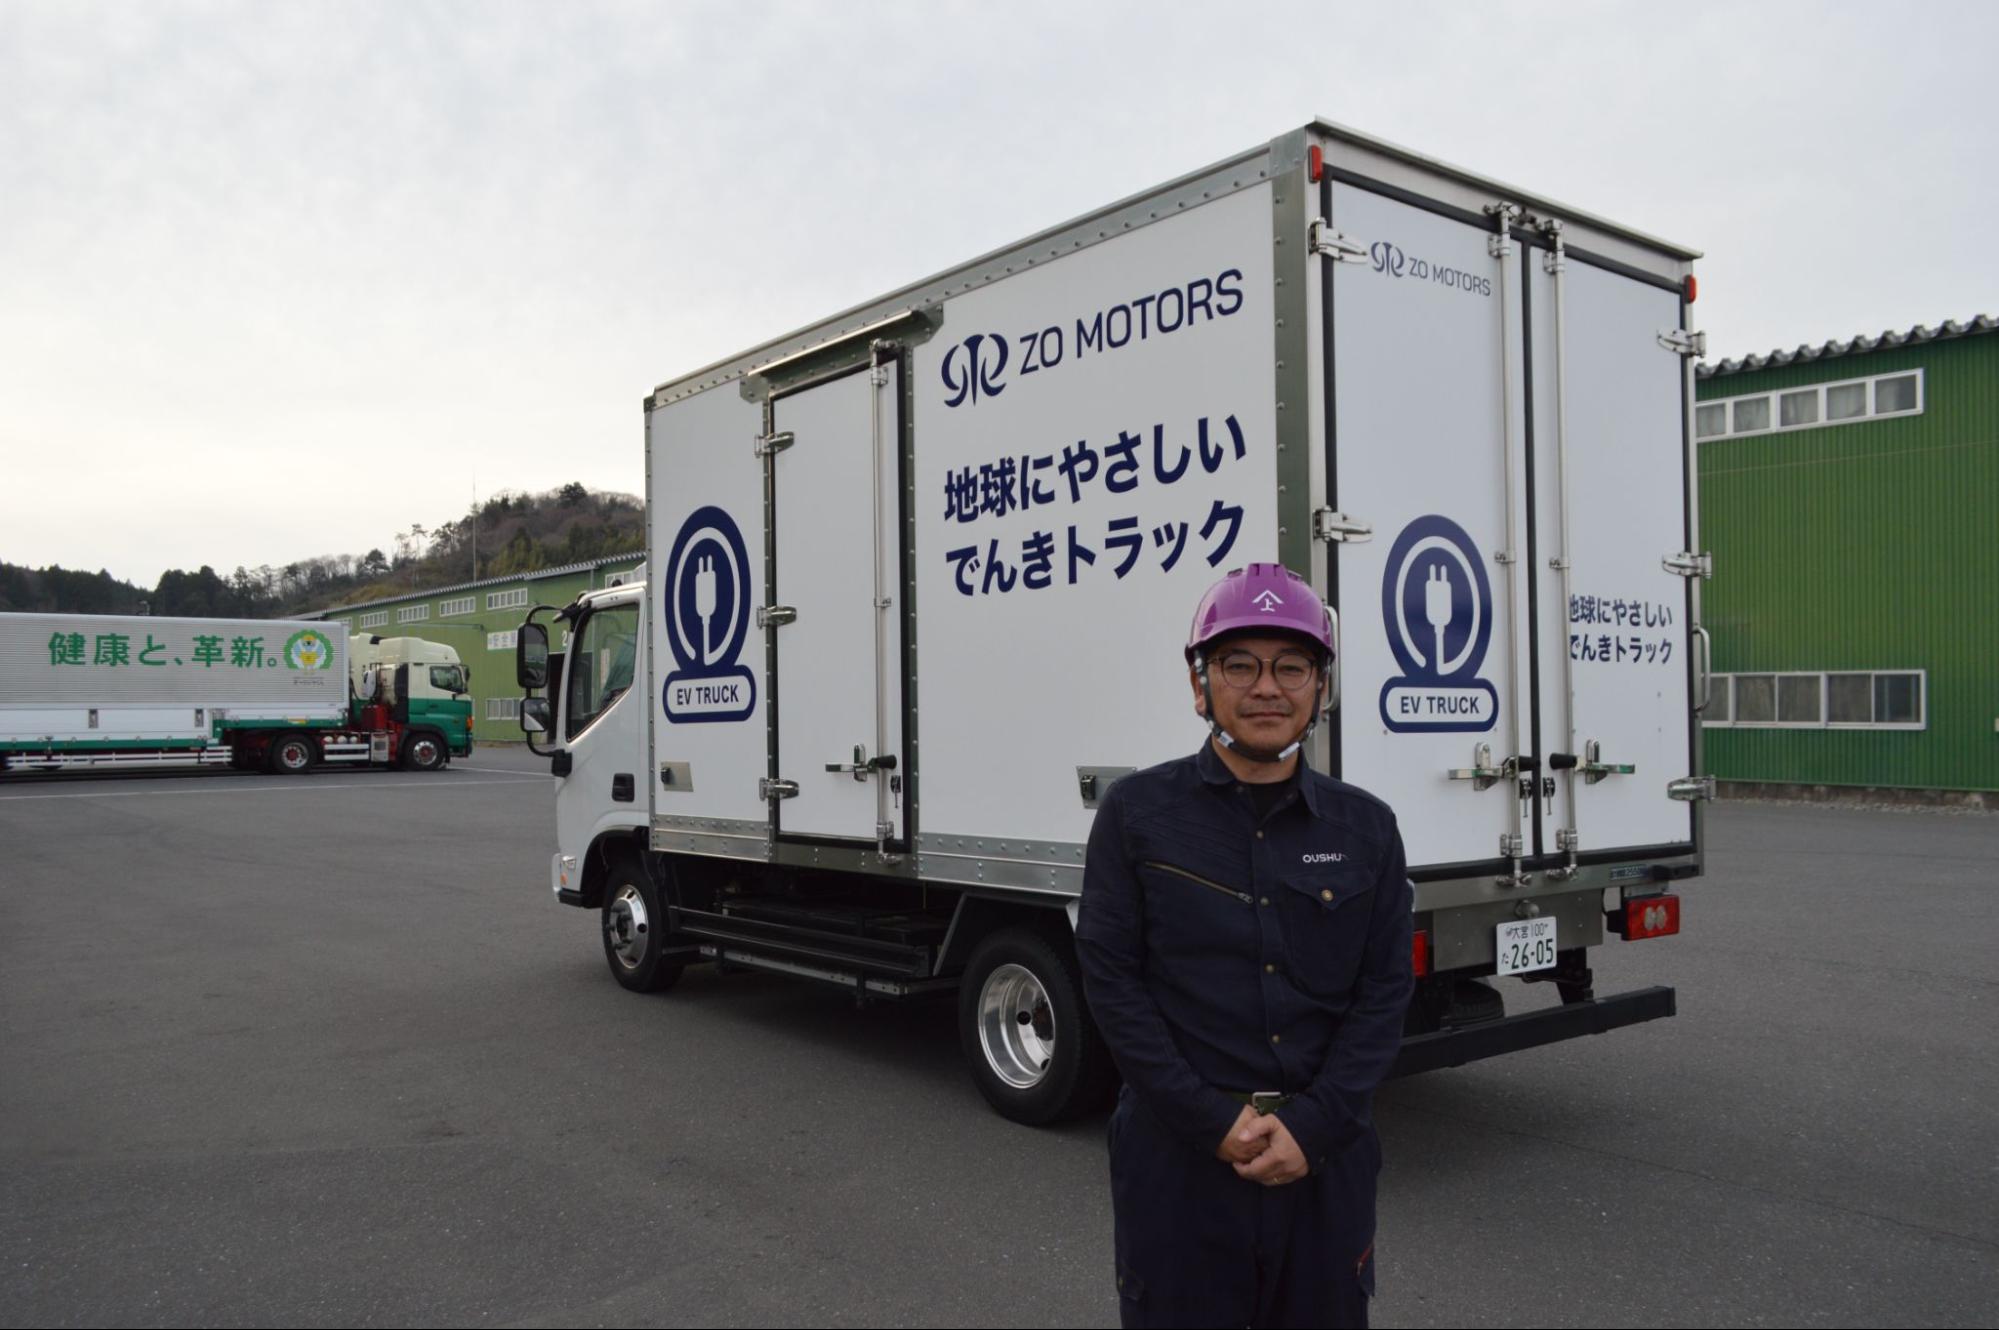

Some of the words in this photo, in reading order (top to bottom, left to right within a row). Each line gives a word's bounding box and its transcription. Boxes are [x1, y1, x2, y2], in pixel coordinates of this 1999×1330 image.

[1409, 256, 1429, 279] ZO
[1432, 263, 1491, 297] MOTORS
[1019, 325, 1064, 376] ZO
[1076, 268, 1244, 359] MOTORS
[943, 414, 1247, 524] 地球にやさしい
[945, 499, 1245, 597] でんきトラック
[48, 631, 278, 668] 健康と、革新。
[561, 629, 568, 647] 2
[676, 687, 692, 706] EV
[695, 684, 739, 705] TRUCK
[1400, 695, 1421, 714] EV
[1426, 695, 1480, 714] TRUCK
[1302, 852, 1343, 864] OUSHU
